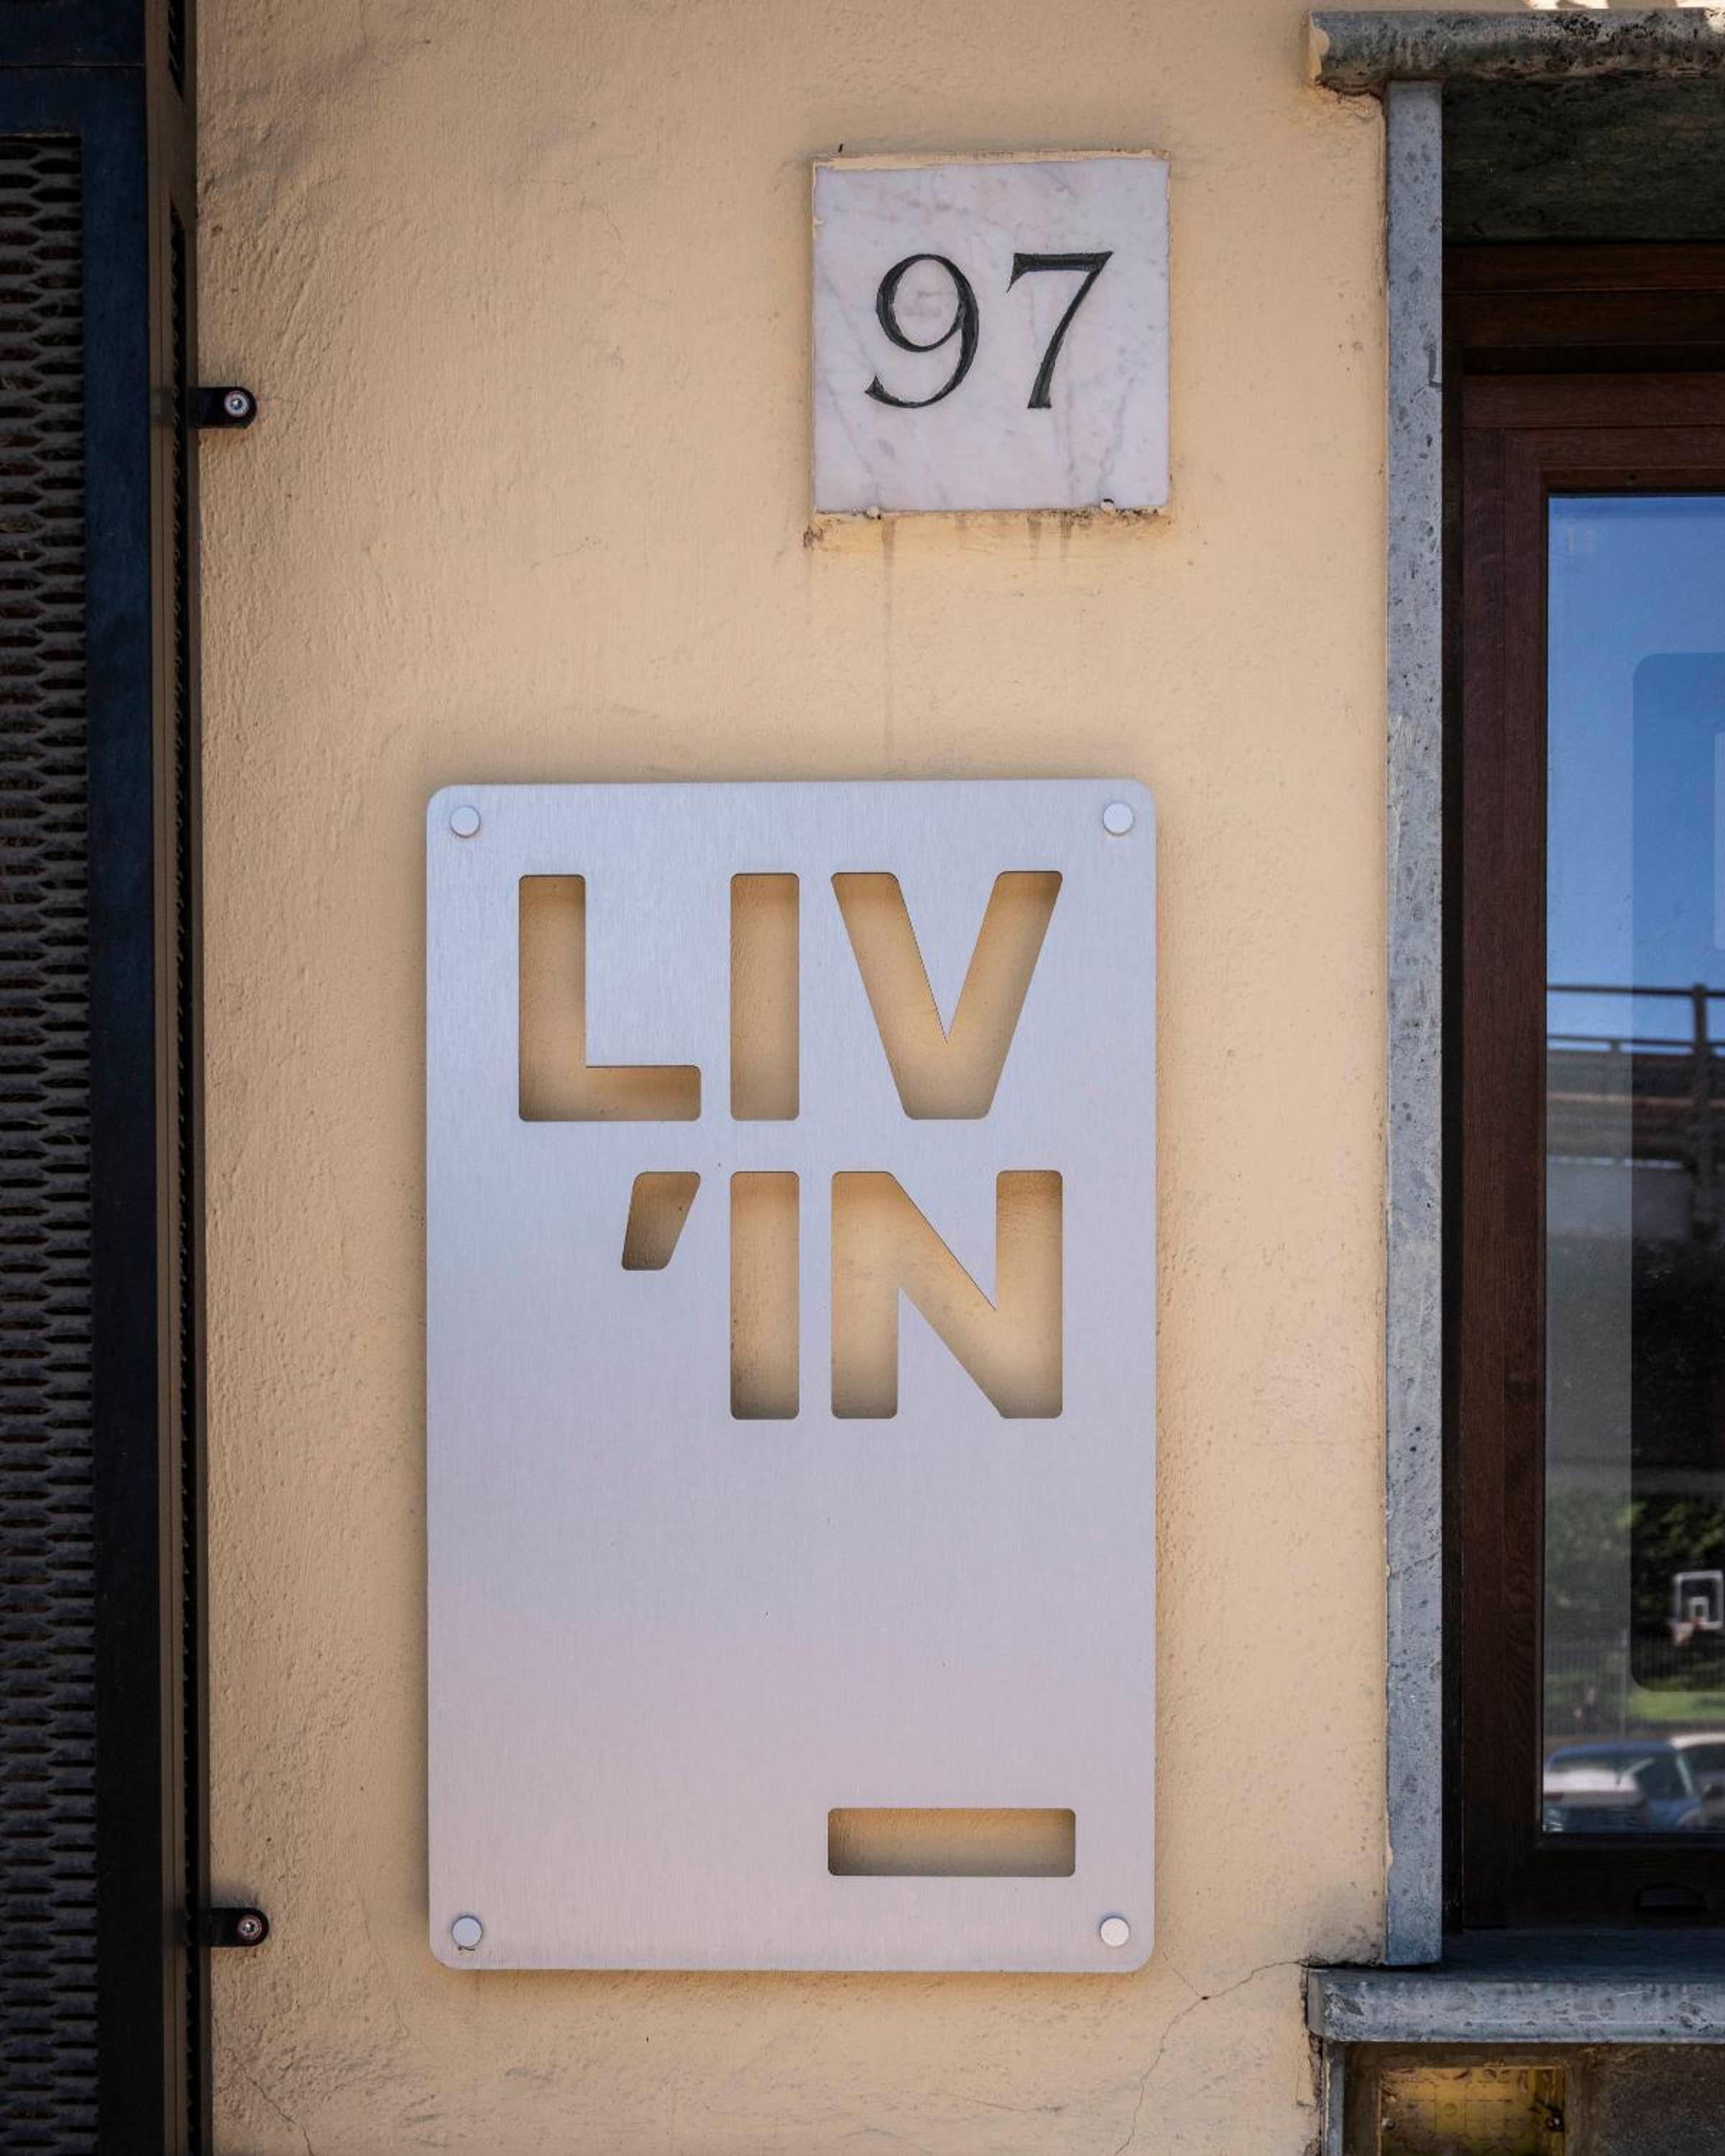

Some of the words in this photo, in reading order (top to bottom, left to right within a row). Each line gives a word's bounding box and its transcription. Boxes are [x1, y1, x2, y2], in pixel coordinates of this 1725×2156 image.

[865, 252, 1113, 409] 97
[519, 871, 1062, 1121] LIV
[621, 1170, 1062, 1420] 'IN
